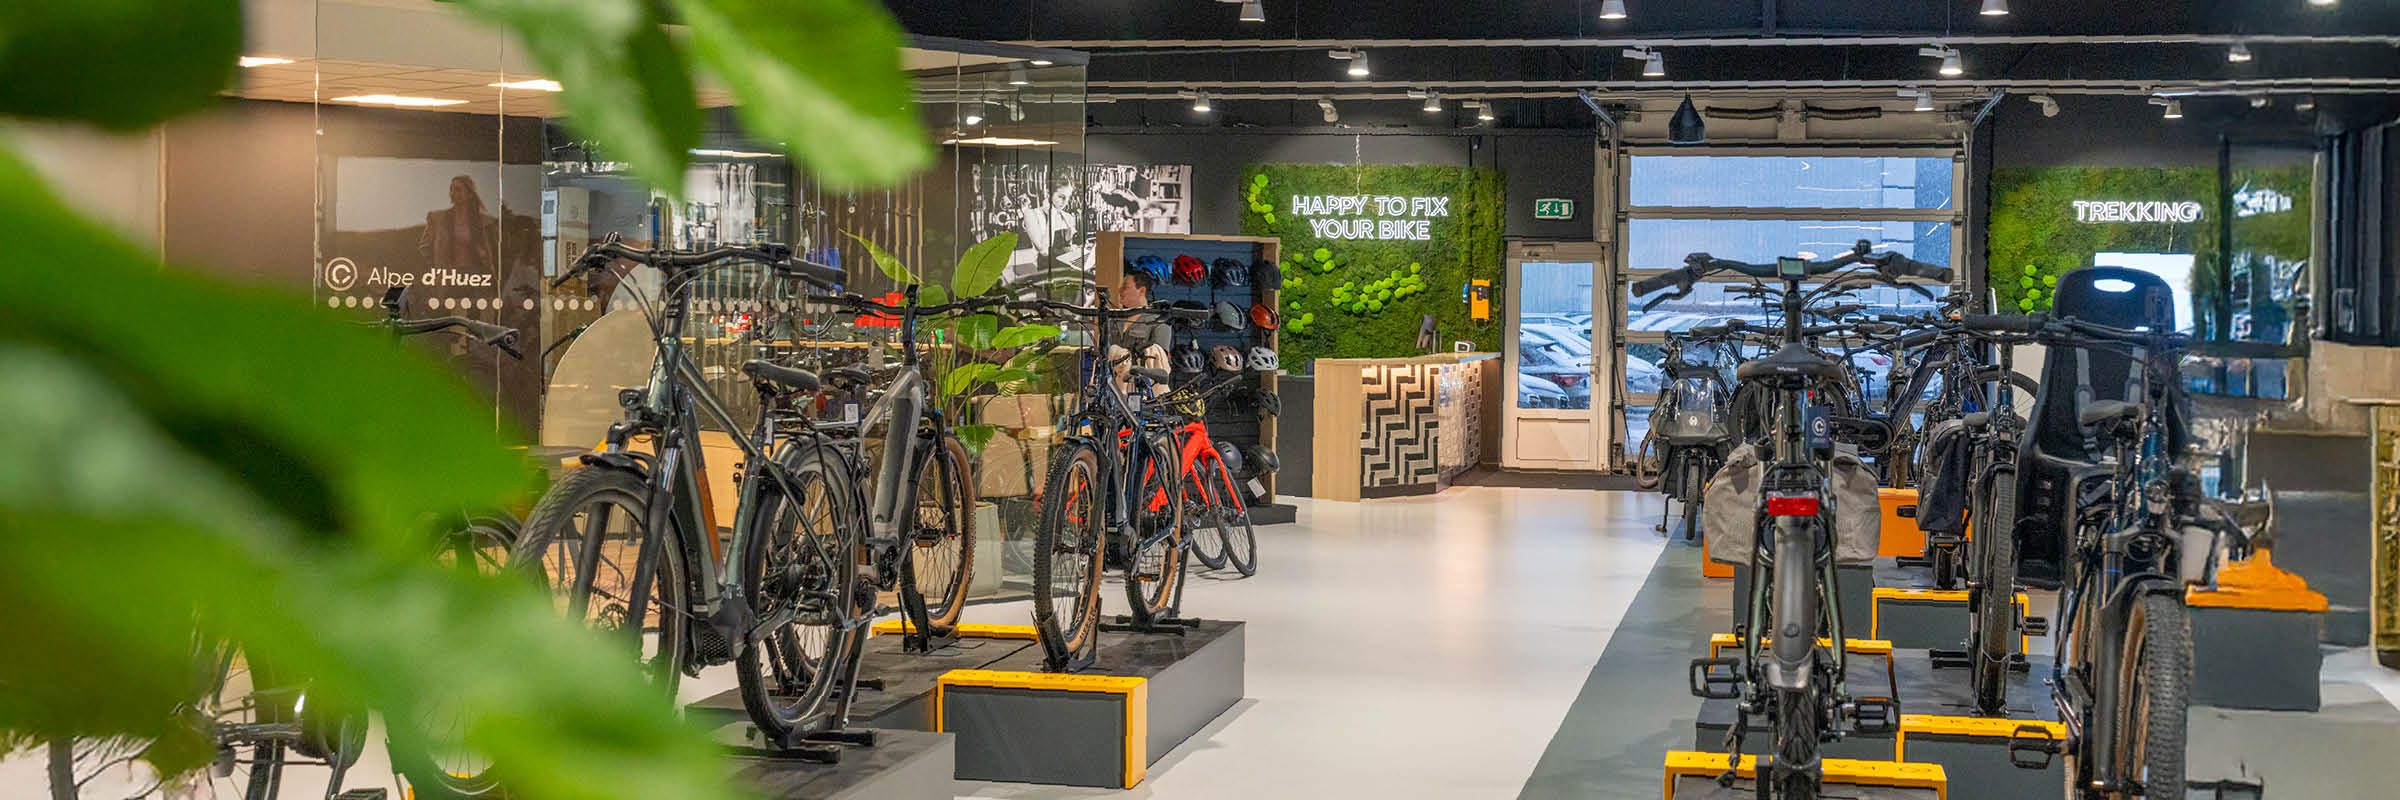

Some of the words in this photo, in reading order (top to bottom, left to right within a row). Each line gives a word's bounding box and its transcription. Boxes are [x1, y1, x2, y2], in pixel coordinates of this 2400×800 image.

[1293, 194, 1368, 216] HAPPY
[1375, 195, 1407, 217] TO
[1411, 196, 1449, 217] FIX
[2073, 200, 2201, 223] TREKKING
[1309, 218, 1374, 240] YOUR
[1378, 219, 1431, 241] BIKE
[367, 266, 415, 288] Alpe
[421, 267, 492, 287] d'Huez
